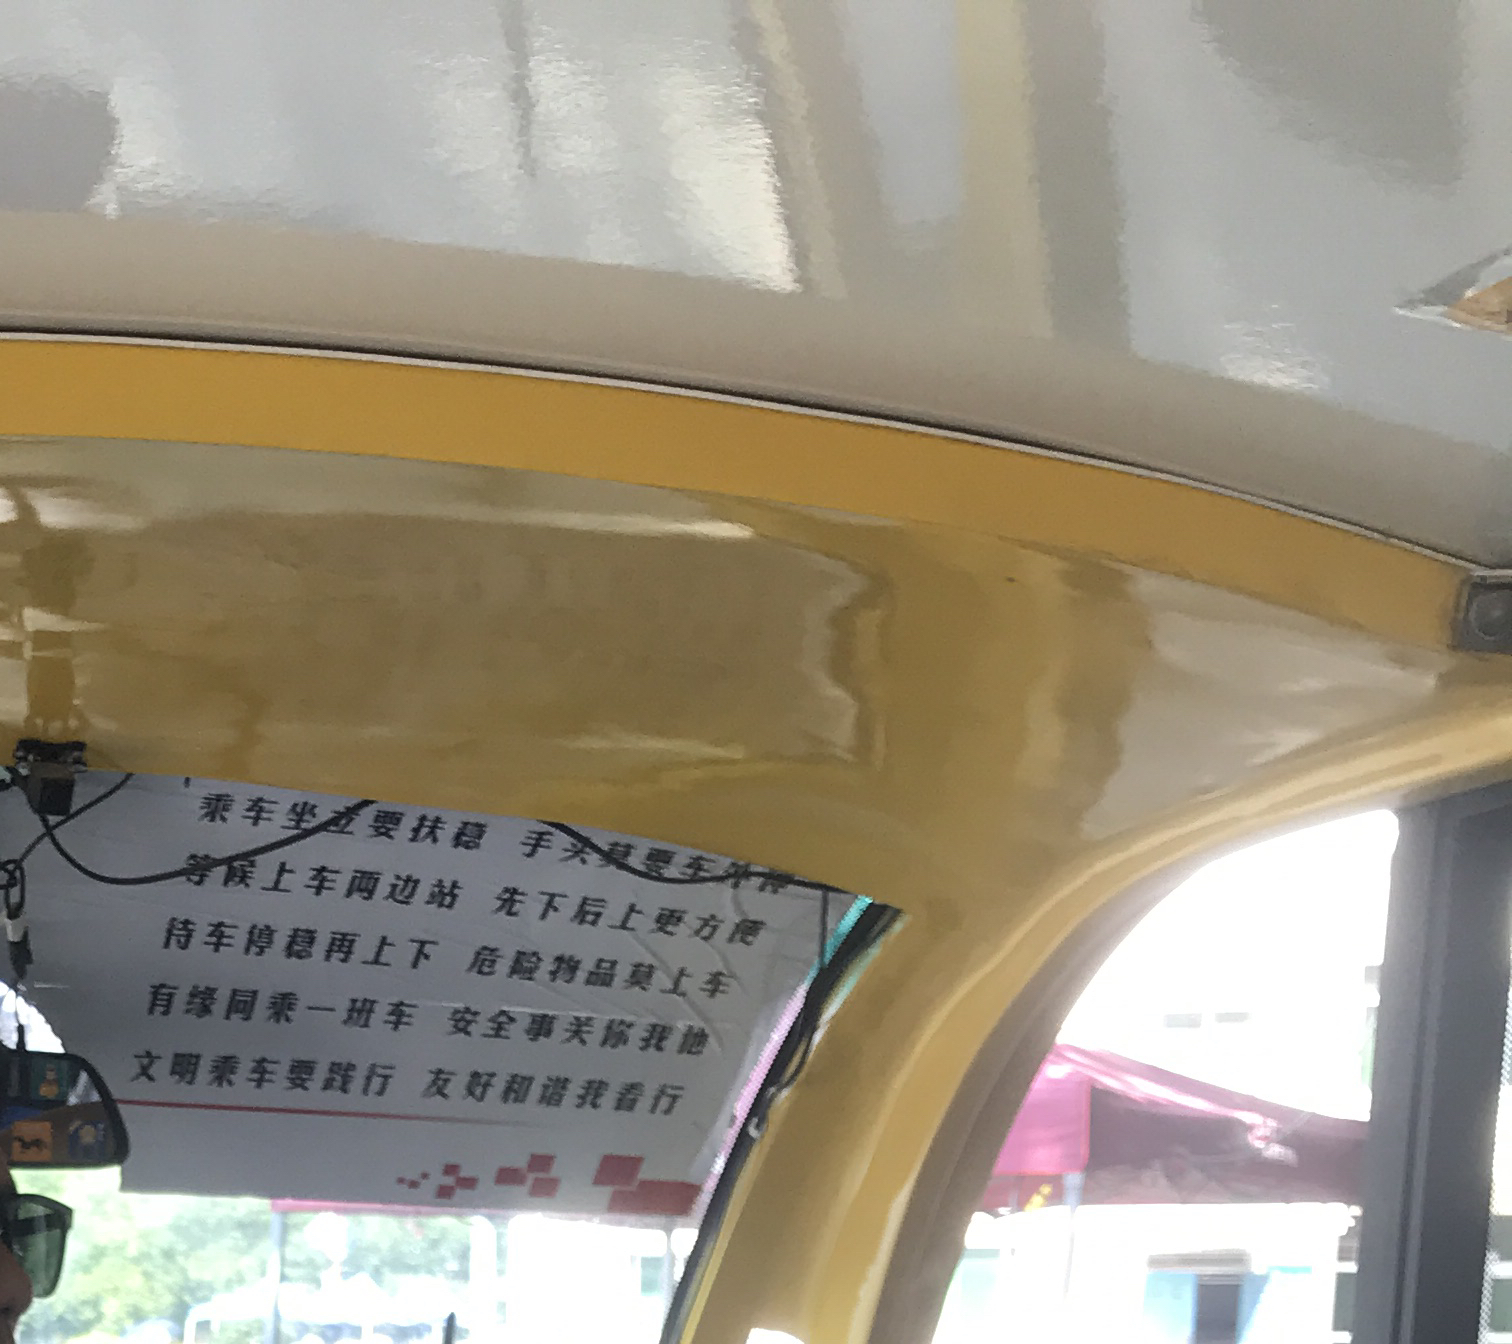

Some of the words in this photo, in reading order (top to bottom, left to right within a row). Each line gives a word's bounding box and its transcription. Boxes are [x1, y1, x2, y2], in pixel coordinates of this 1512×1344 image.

[197, 792, 488, 851] 乘车坐立要扶稳
[186, 852, 463, 910] 等候上车两边站
[492, 886, 767, 946] 先下后上更方便
[163, 916, 439, 969] 待车停稳再上下
[465, 944, 736, 999] 危险物品莫上车
[147, 982, 420, 1032] 有缘同乘一班车
[446, 1006, 711, 1056] 安全事关你我他
[130, 1050, 397, 1098] 文明乘车要践行
[422, 1067, 686, 1116] 友好和谐我看行
